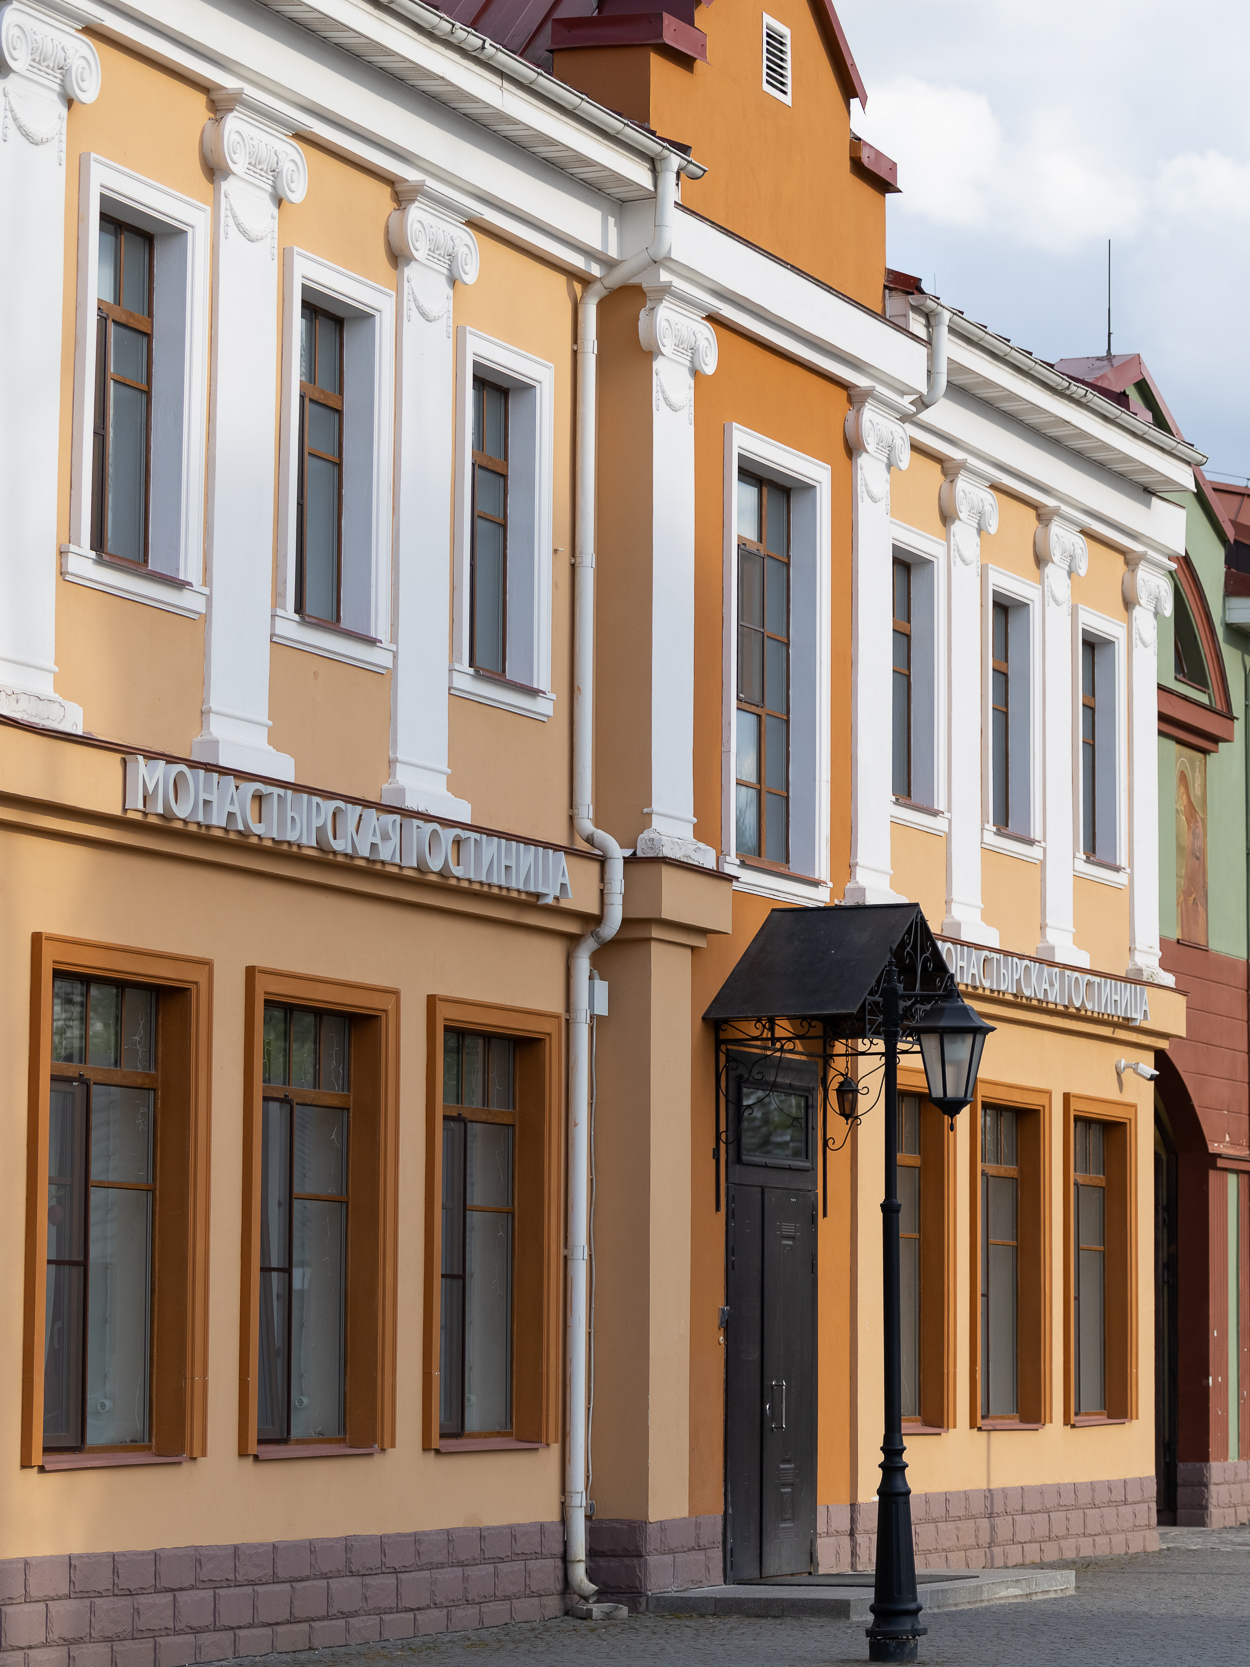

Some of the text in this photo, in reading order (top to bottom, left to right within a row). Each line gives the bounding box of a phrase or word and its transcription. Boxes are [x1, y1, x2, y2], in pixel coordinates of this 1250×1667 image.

[125, 754, 573, 904] МОНАСТЫРСКАЯ ГОСТИНИЦА
[936, 940, 1150, 1025] ОНАСТЫРСКАЯ ГОСТИНИЦА
